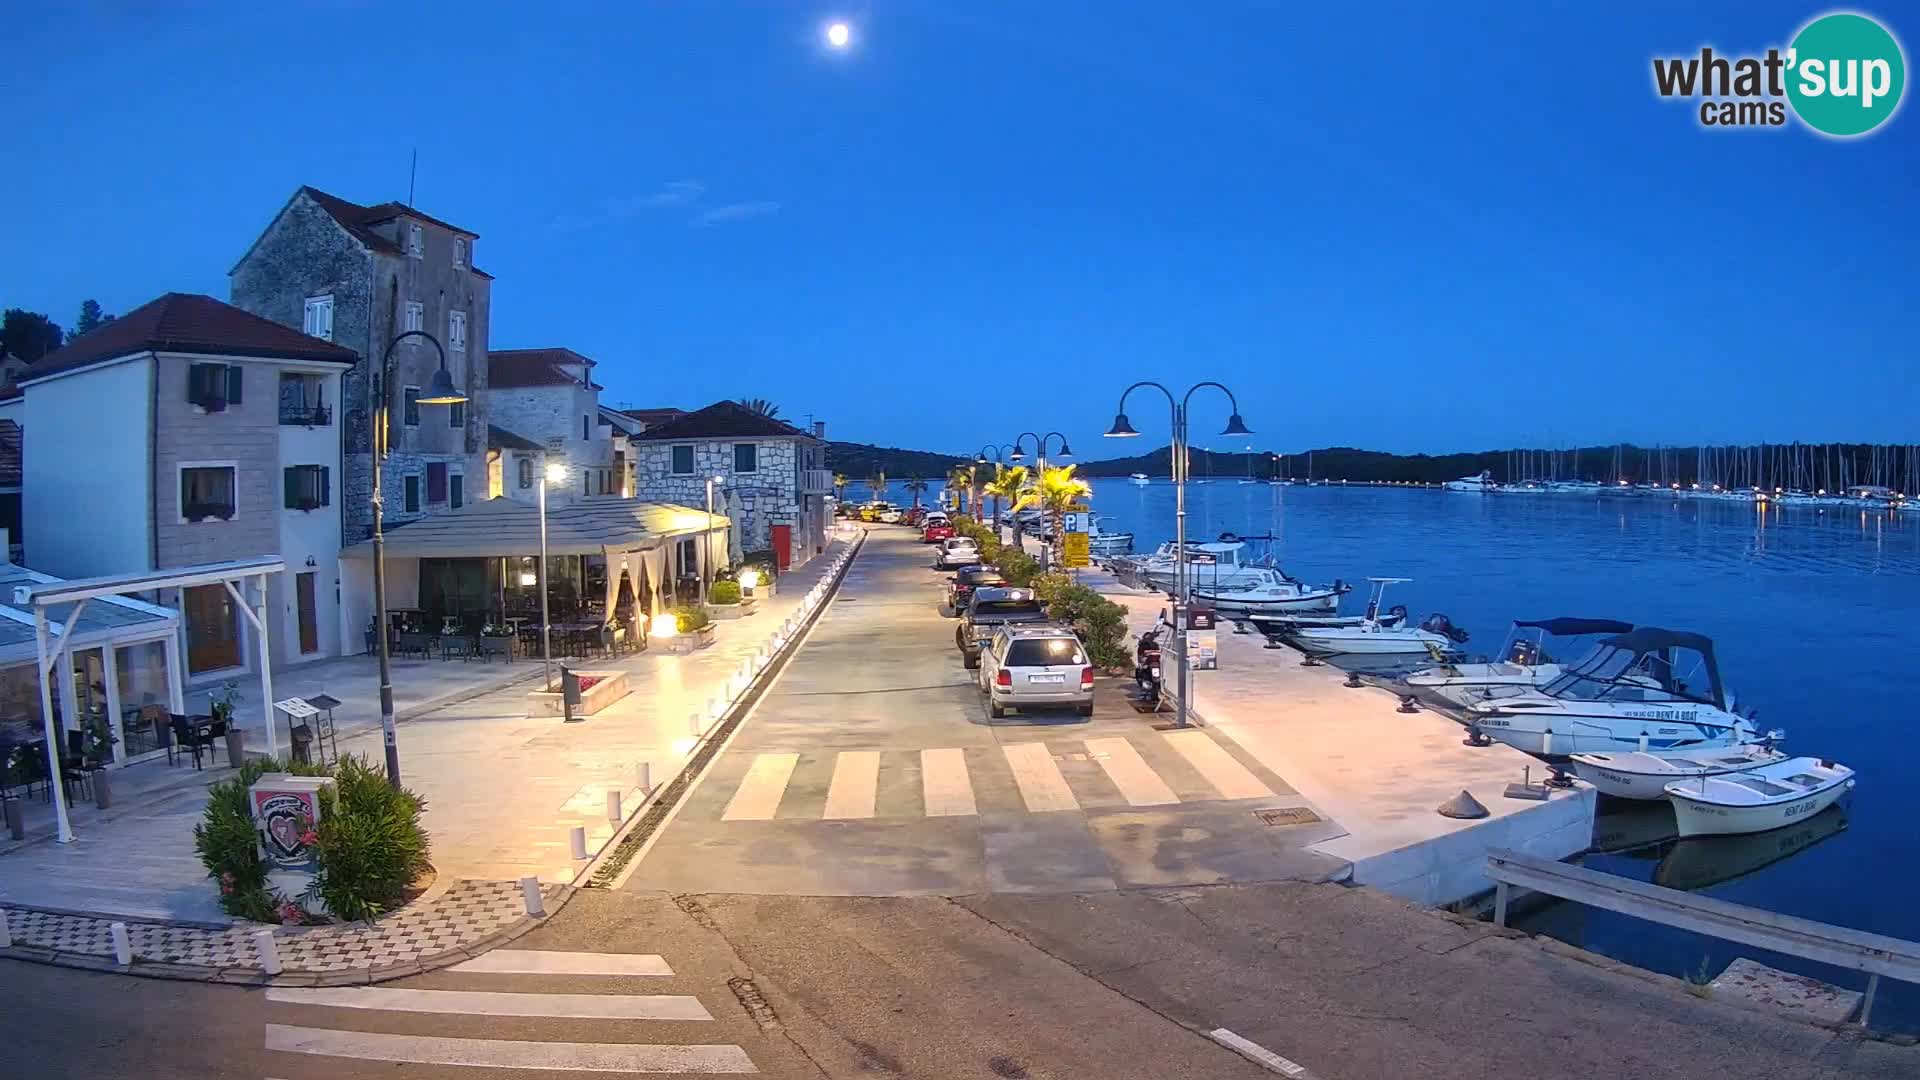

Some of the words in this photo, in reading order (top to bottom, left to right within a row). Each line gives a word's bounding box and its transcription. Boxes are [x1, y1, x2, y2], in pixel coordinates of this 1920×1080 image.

[1065, 514, 1077, 530] P
[1656, 710, 1674, 720] RENT
[1681, 711, 1697, 721] BOAT
